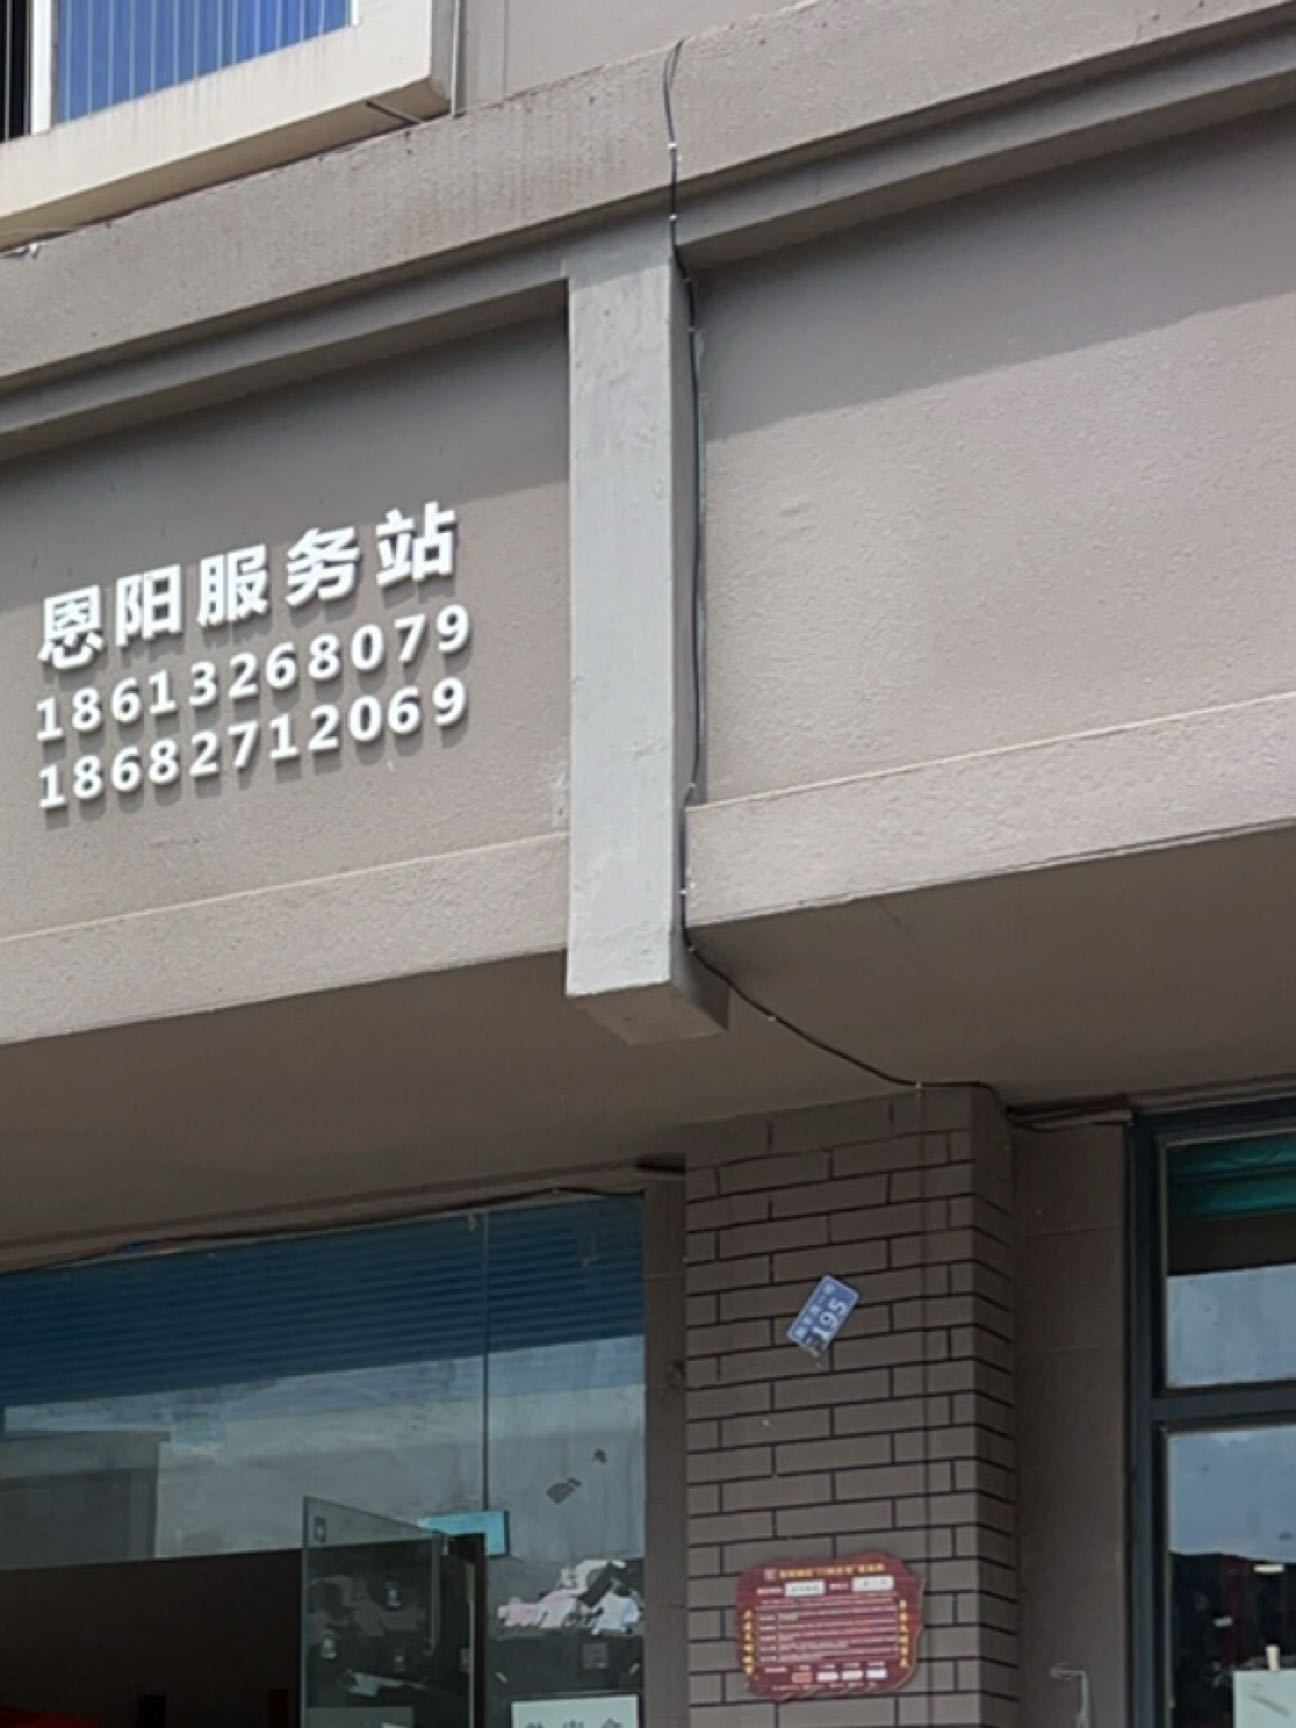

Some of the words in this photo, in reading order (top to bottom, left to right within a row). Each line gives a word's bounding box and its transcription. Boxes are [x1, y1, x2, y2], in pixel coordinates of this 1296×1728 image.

[37, 501, 457, 671] 恩阳服务站
[37, 604, 470, 741] 18613268079
[39, 677, 467, 810] 18682712069
